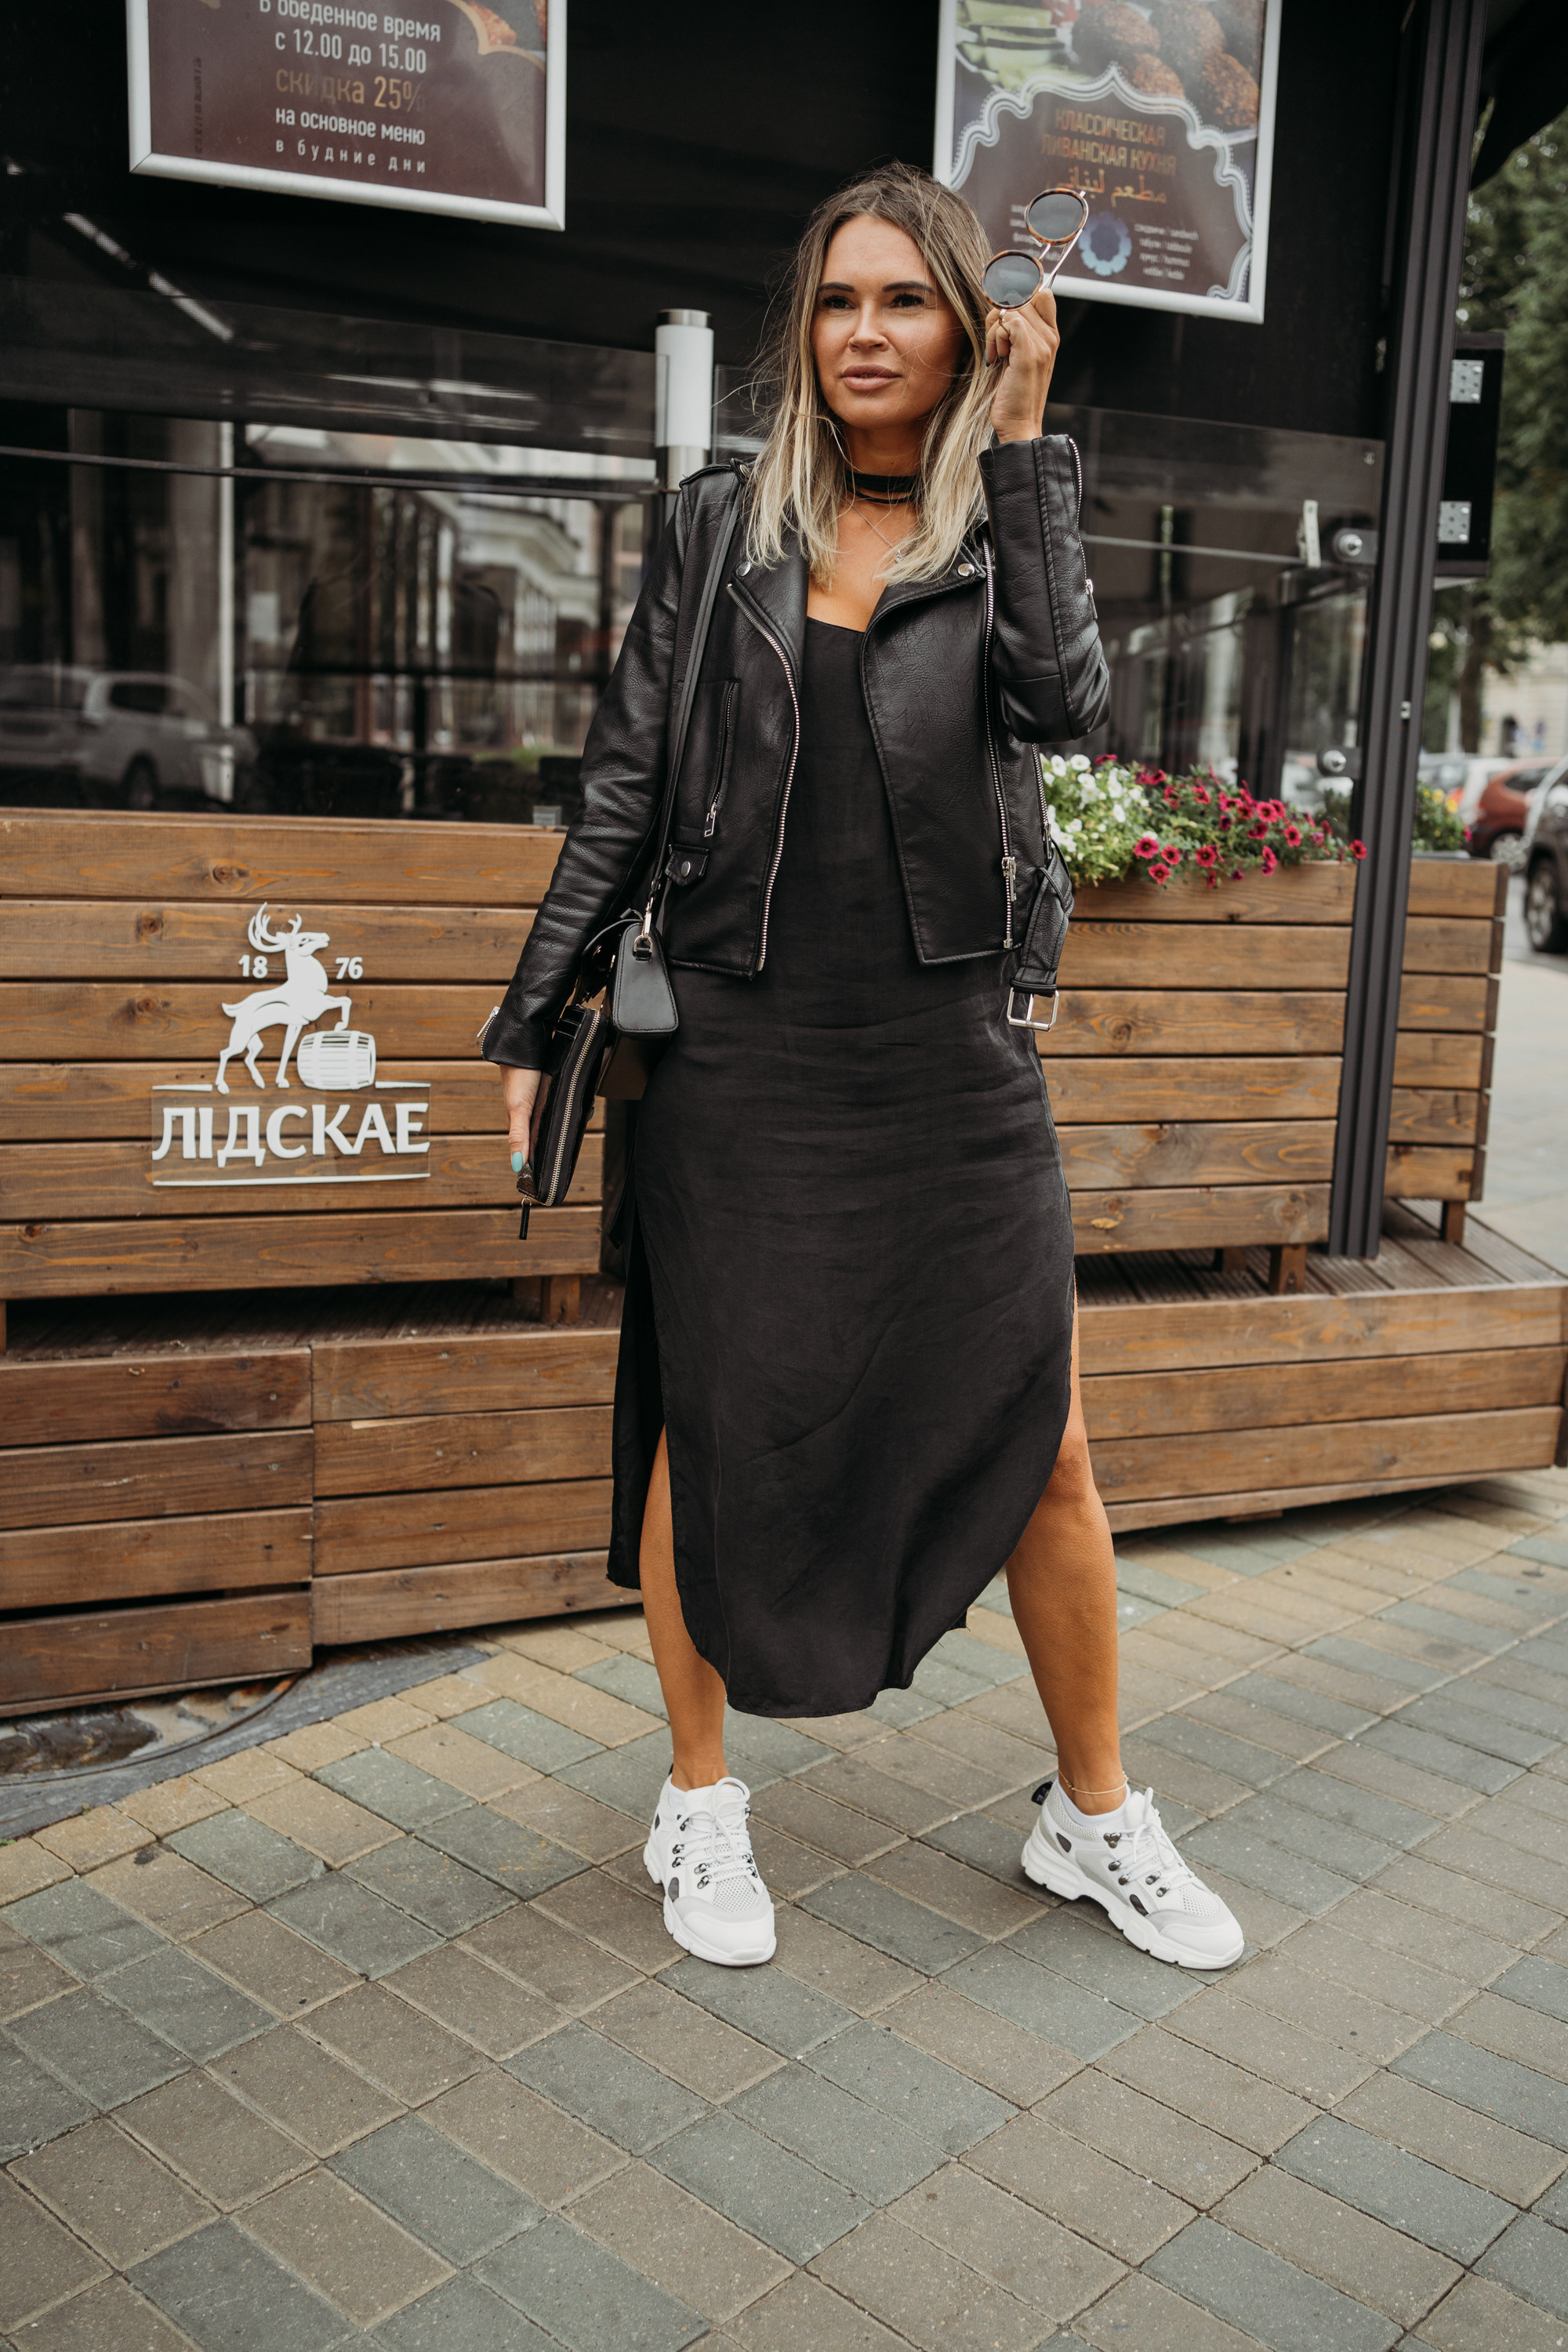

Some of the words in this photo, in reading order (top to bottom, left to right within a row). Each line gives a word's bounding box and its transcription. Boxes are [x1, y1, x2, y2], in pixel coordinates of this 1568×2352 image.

[278, 0, 378, 31] обеденное
[383, 15, 441, 42] время
[274, 31, 286, 50] с
[292, 28, 343, 60] 12.00
[347, 44, 372, 67] до
[379, 42, 427, 74] 15.00
[373, 75, 426, 113] 25%
[275, 107, 296, 125] на
[300, 111, 376, 138] основное
[381, 124, 426, 145] меню
[1054, 108, 1167, 147] КЛАССИЧЕСКАЯ
[275, 139, 284, 152] в
[297, 139, 376, 165] будние
[387, 156, 426, 173] дни
[1040, 133, 1127, 168] ЛИВАНСКАЯ
[1130, 148, 1177, 176] КУХНЯ
[238, 954, 268, 978] 18
[335, 956, 364, 980] 76
[151, 1102, 430, 1168] ЛІДСКАЕ
